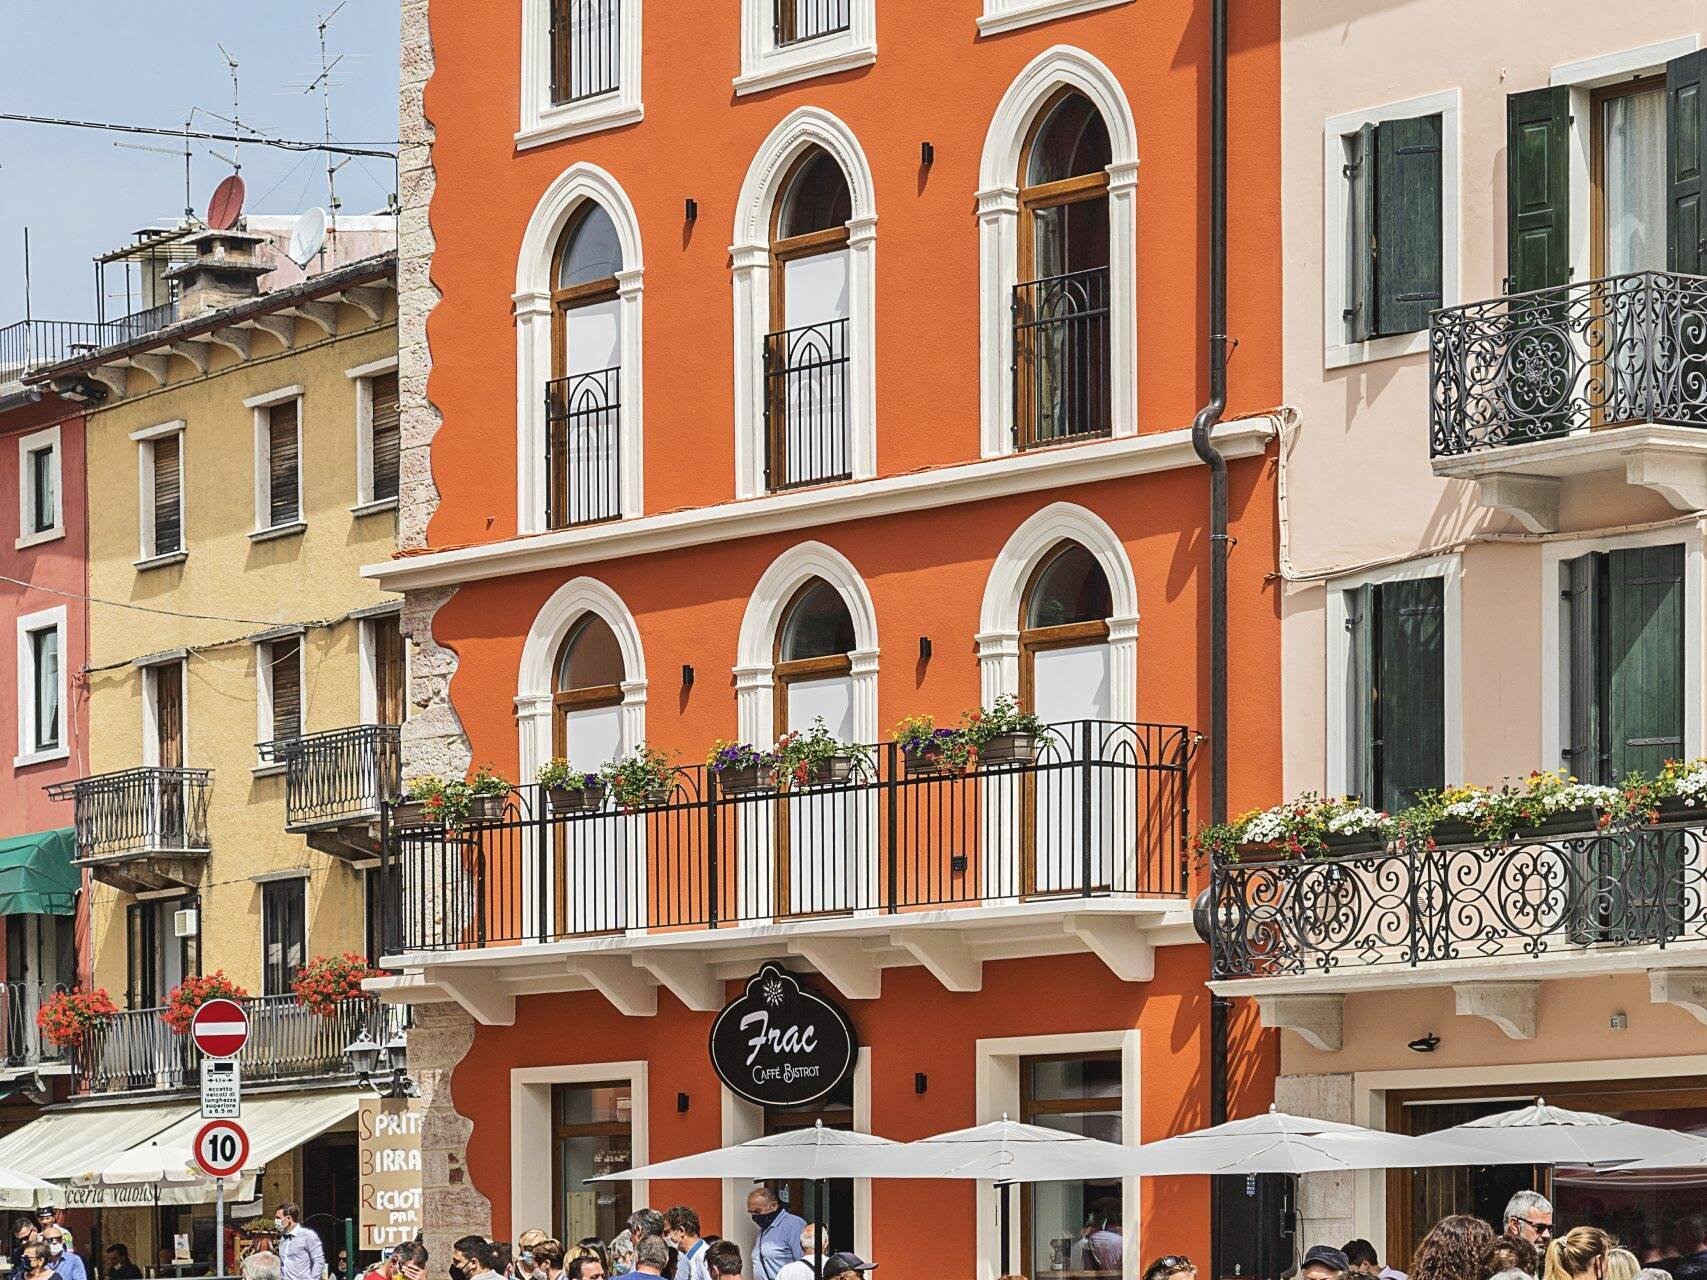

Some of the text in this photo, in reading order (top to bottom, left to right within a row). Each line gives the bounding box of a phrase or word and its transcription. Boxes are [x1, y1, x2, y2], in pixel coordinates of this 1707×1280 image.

[740, 1010, 818, 1065] Frac
[360, 1109, 422, 1141] SPRIT
[208, 1134, 236, 1162] 10
[361, 1149, 422, 1176] BIRRA
[361, 1183, 423, 1211] RECIOT
